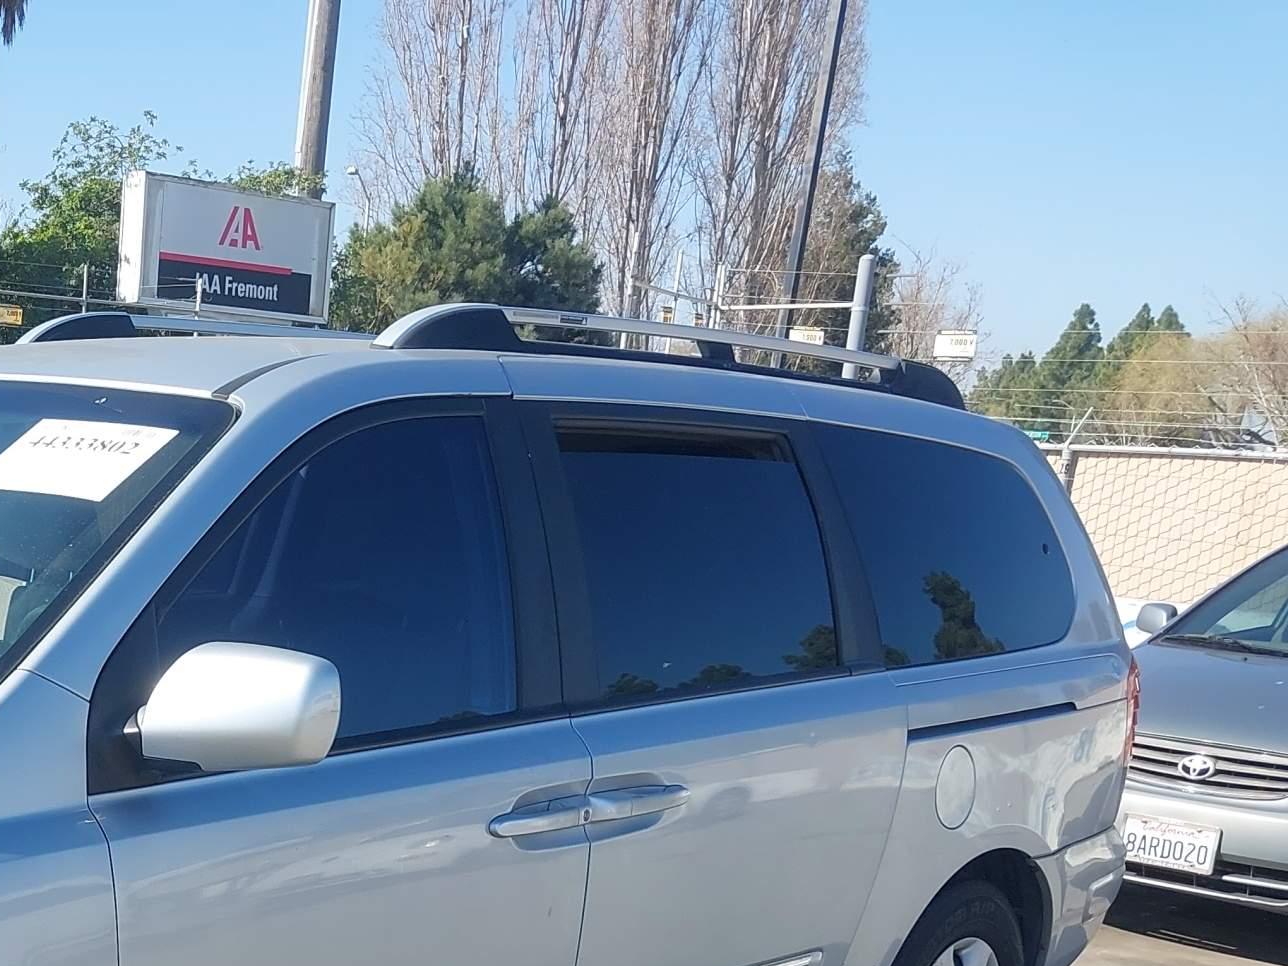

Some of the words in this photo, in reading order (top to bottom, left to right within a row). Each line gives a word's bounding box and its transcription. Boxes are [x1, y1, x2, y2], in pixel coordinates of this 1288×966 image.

[224, 275, 279, 301] Fremont
[28, 435, 141, 455] 44333802
[1125, 832, 1209, 866] 8ARD020
